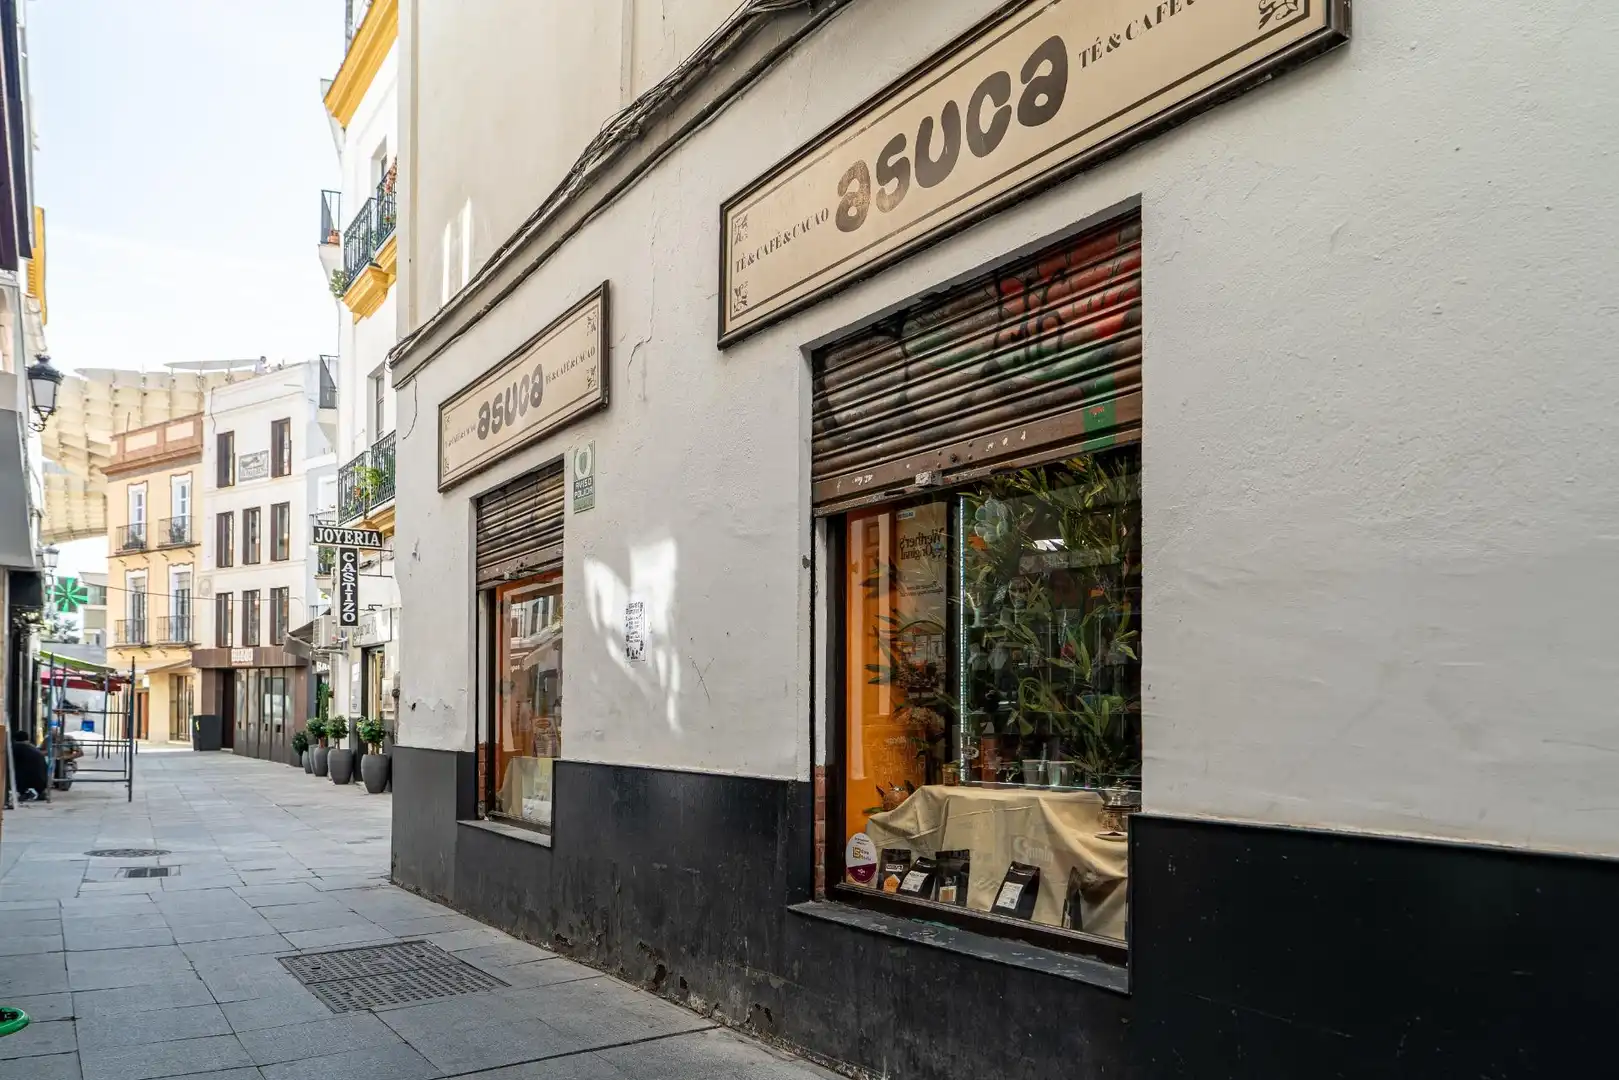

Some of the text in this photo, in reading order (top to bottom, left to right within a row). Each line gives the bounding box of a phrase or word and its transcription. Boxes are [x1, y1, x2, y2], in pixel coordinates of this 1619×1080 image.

[834, 34, 1069, 233] asuca
[477, 364, 544, 441] asuca
[575, 477, 592, 491] AVISO
[315, 527, 381, 546] JOYERIA
[341, 552, 356, 623] CASTIZO
